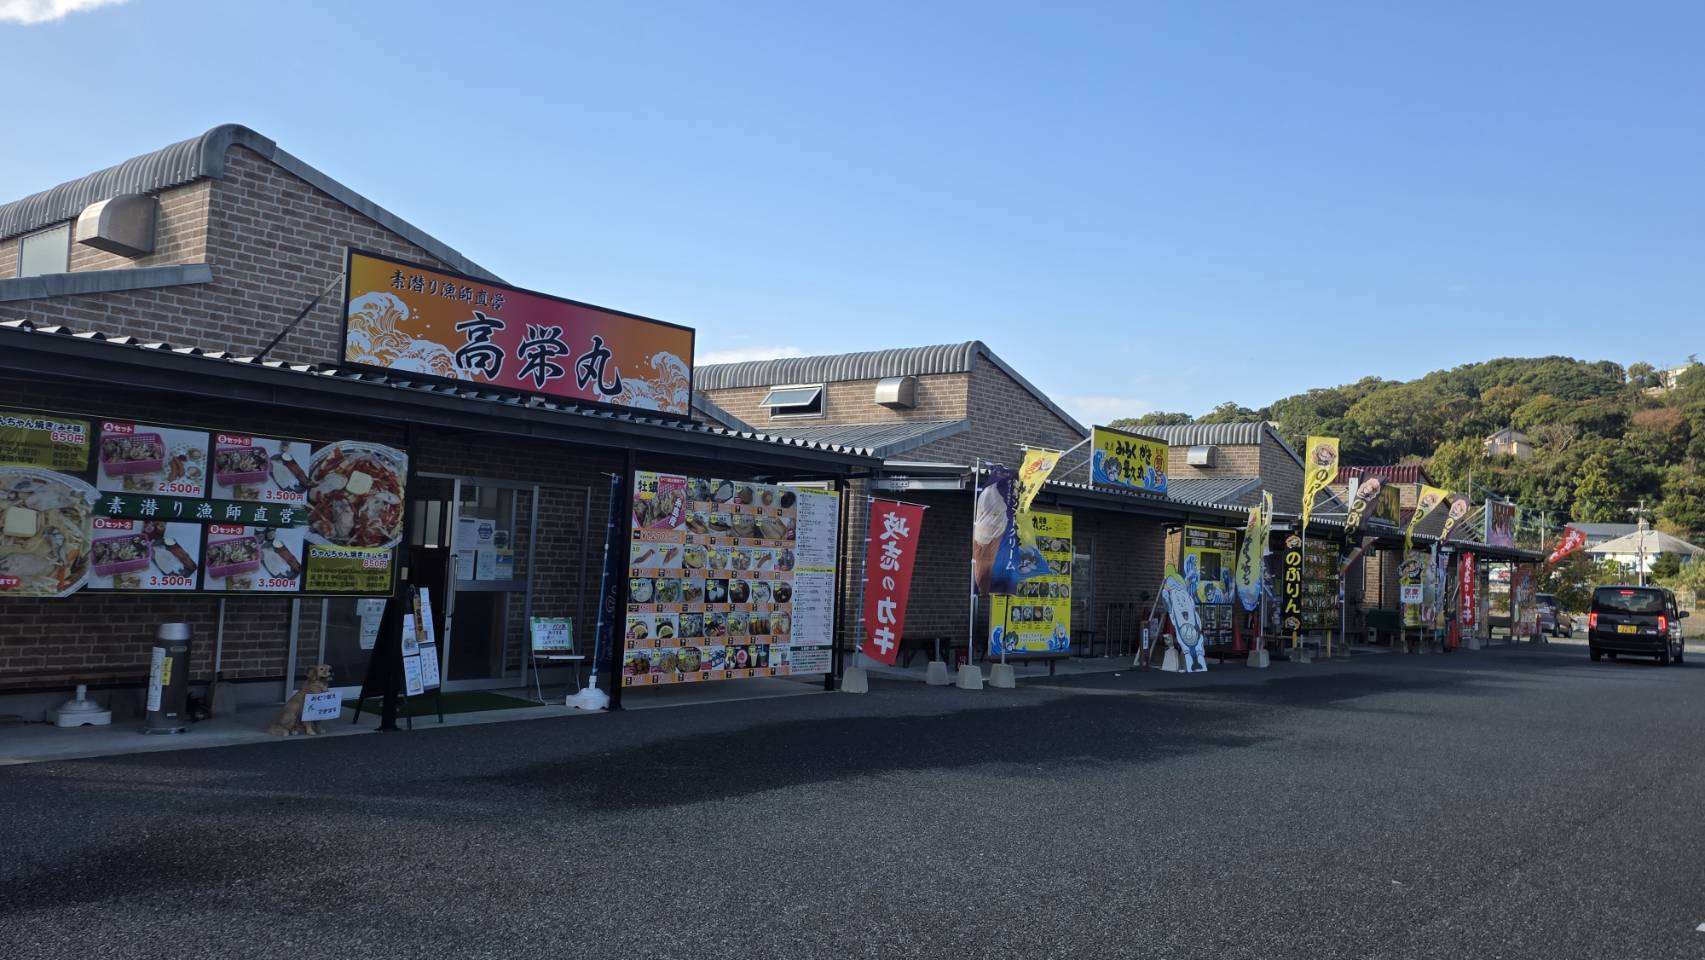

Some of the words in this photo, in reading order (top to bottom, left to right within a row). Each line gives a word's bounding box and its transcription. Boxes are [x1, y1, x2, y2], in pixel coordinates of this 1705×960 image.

[390, 269, 505, 311] 素潜り漁師直営
[454, 310, 623, 396] 高栄丸
[51, 432, 86, 444] 850円
[159, 481, 201, 495] 2,500円
[266, 490, 304, 502] 3,500円
[106, 496, 295, 524] 素潜り漁師直営
[149, 576, 193, 587] 3,500円
[258, 577, 296, 588] 3,500円
[1285, 551, 1302, 614] のぶりん
